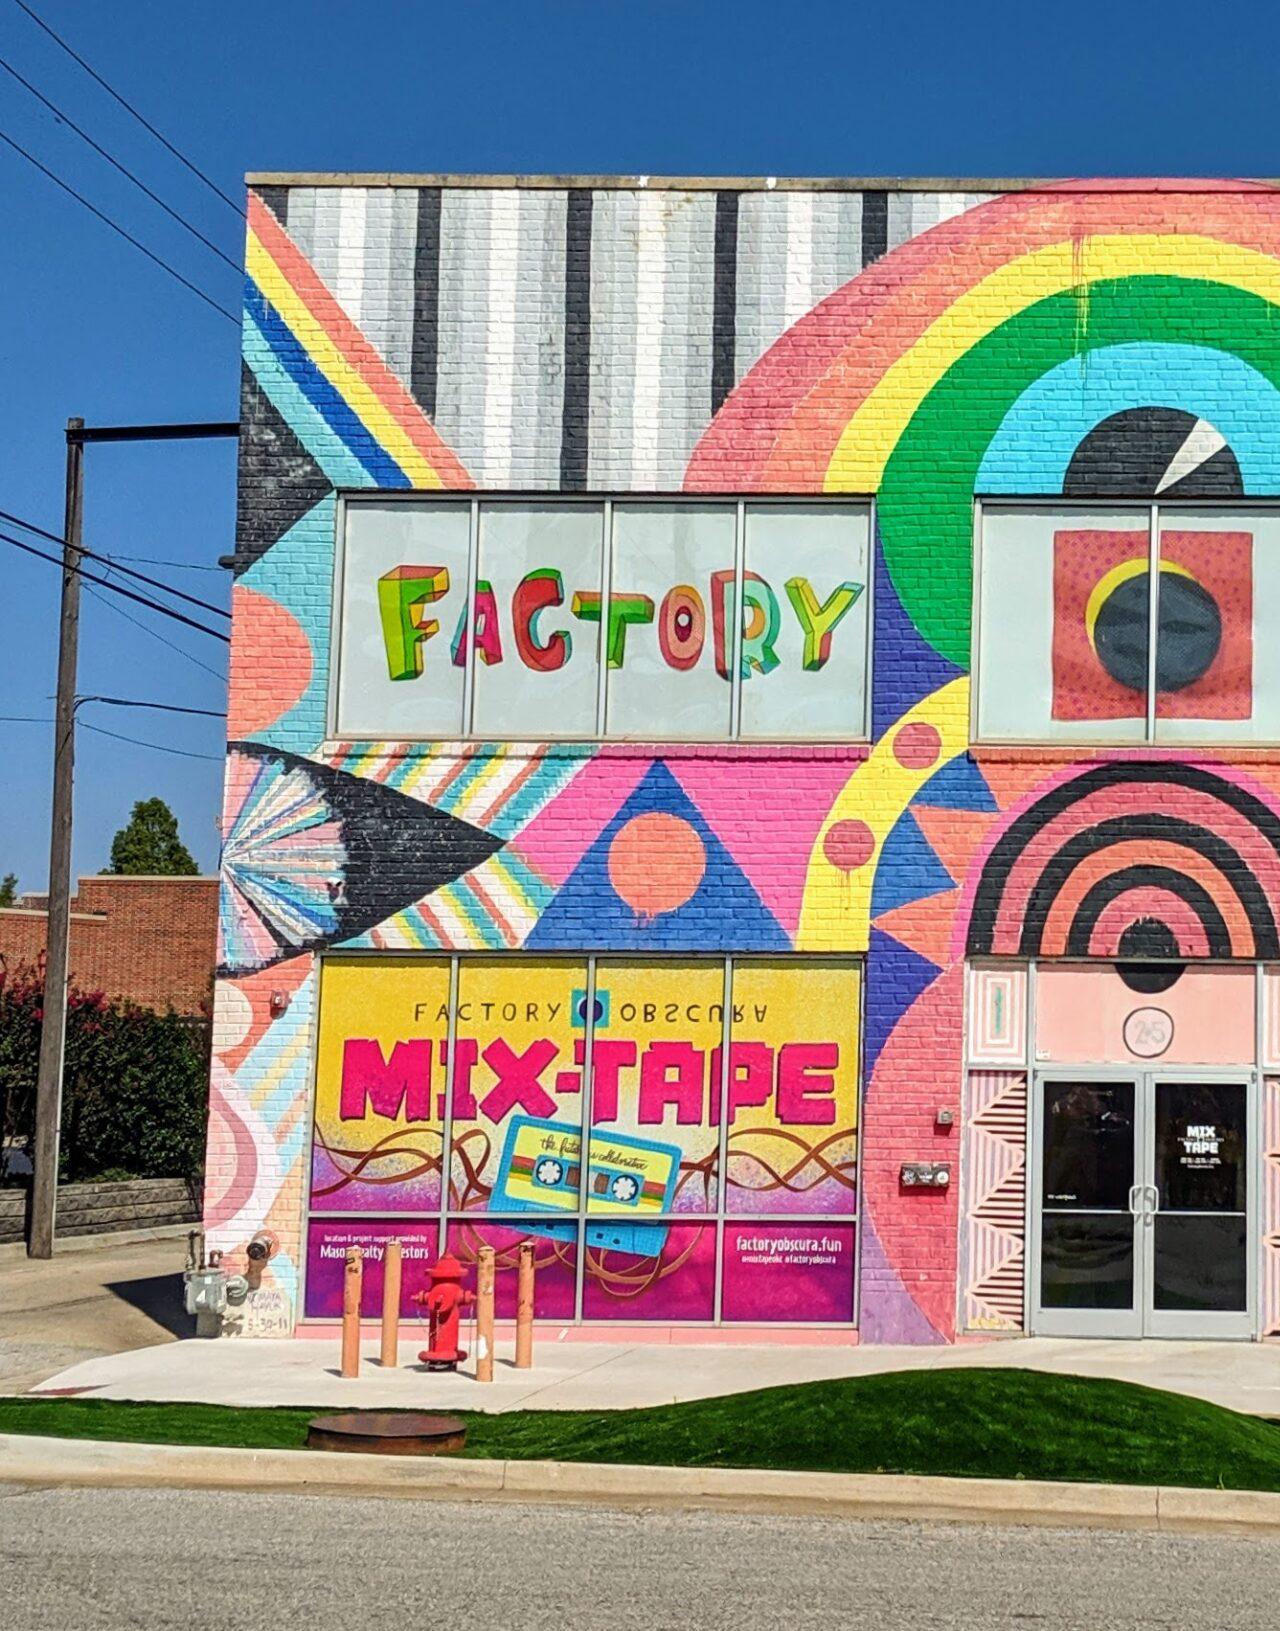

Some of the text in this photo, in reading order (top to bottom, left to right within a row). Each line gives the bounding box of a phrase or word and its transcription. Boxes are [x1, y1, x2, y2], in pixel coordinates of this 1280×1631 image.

[378, 565, 865, 682] FACTORY
[414, 1003, 561, 1022] FACTORY
[340, 1038, 839, 1125] MIX-TAPE
[1187, 1125, 1216, 1138] MIX
[540, 1134, 556, 1151] the
[559, 1137, 582, 1157] futu
[1183, 1141, 1219, 1154] TAPE
[320, 1244, 346, 1259] Maso
[361, 1245, 384, 1261] ealty
[736, 1236, 842, 1255] factoryobscura.fun
